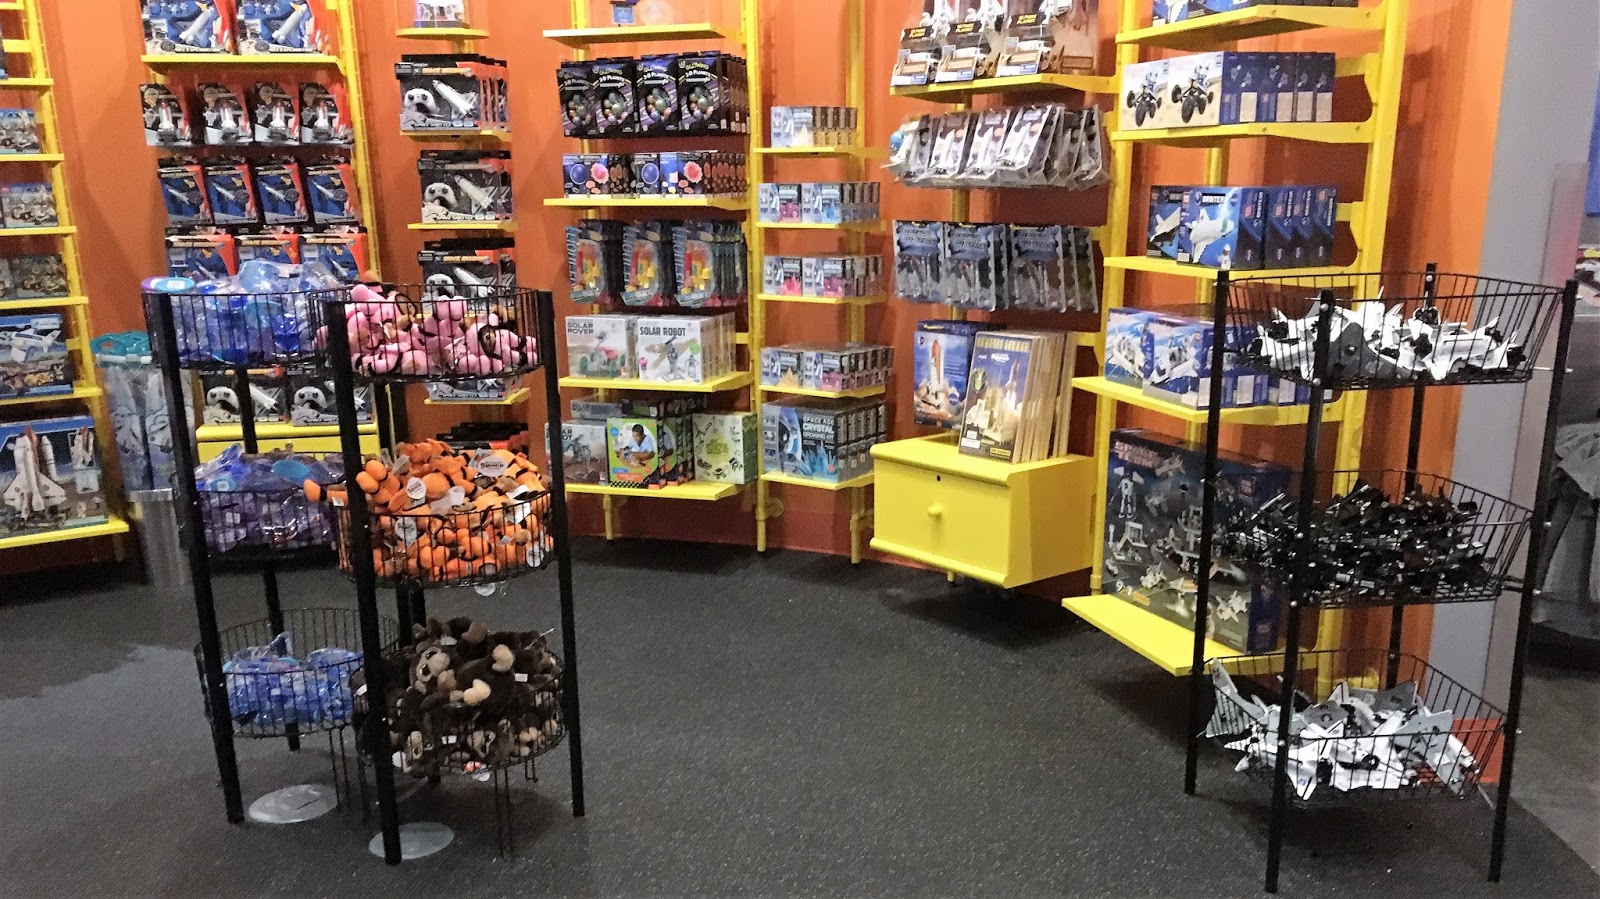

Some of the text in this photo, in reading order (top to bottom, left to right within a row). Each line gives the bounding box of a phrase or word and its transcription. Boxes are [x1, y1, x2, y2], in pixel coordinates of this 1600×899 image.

[639, 326, 686, 337] SOLAR ROBOT
[802, 416, 822, 424] SPACE
[802, 422, 835, 434] CRYSTAL
